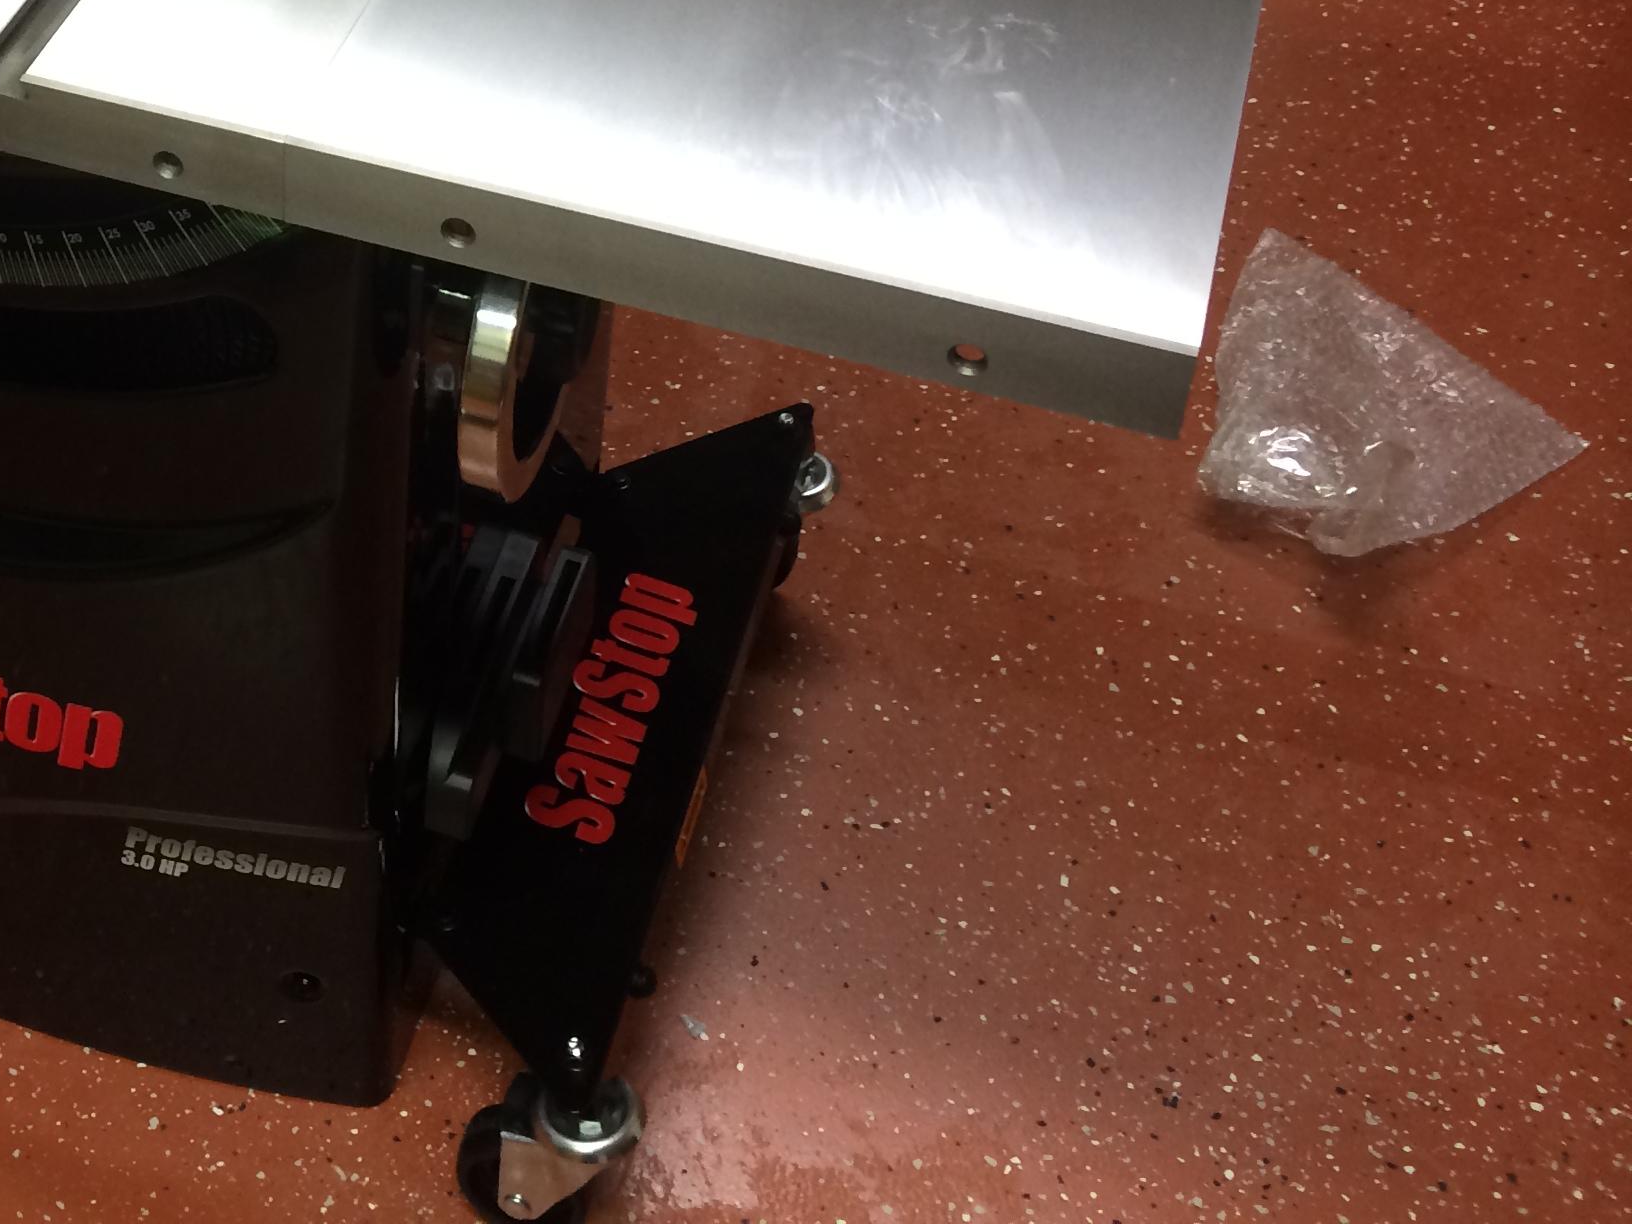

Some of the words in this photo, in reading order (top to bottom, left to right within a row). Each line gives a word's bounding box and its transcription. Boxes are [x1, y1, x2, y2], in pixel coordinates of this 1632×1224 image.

[29, 234, 44, 245] 15
[67, 232, 83, 244] 20
[105, 227, 121, 239] 25
[139, 220, 156, 232] 30
[175, 208, 192, 221] 35
[524, 573, 698, 844] SawStop
[121, 849, 156, 871] 3.0
[158, 858, 189, 877] HP
[125, 827, 346, 889] Professional
